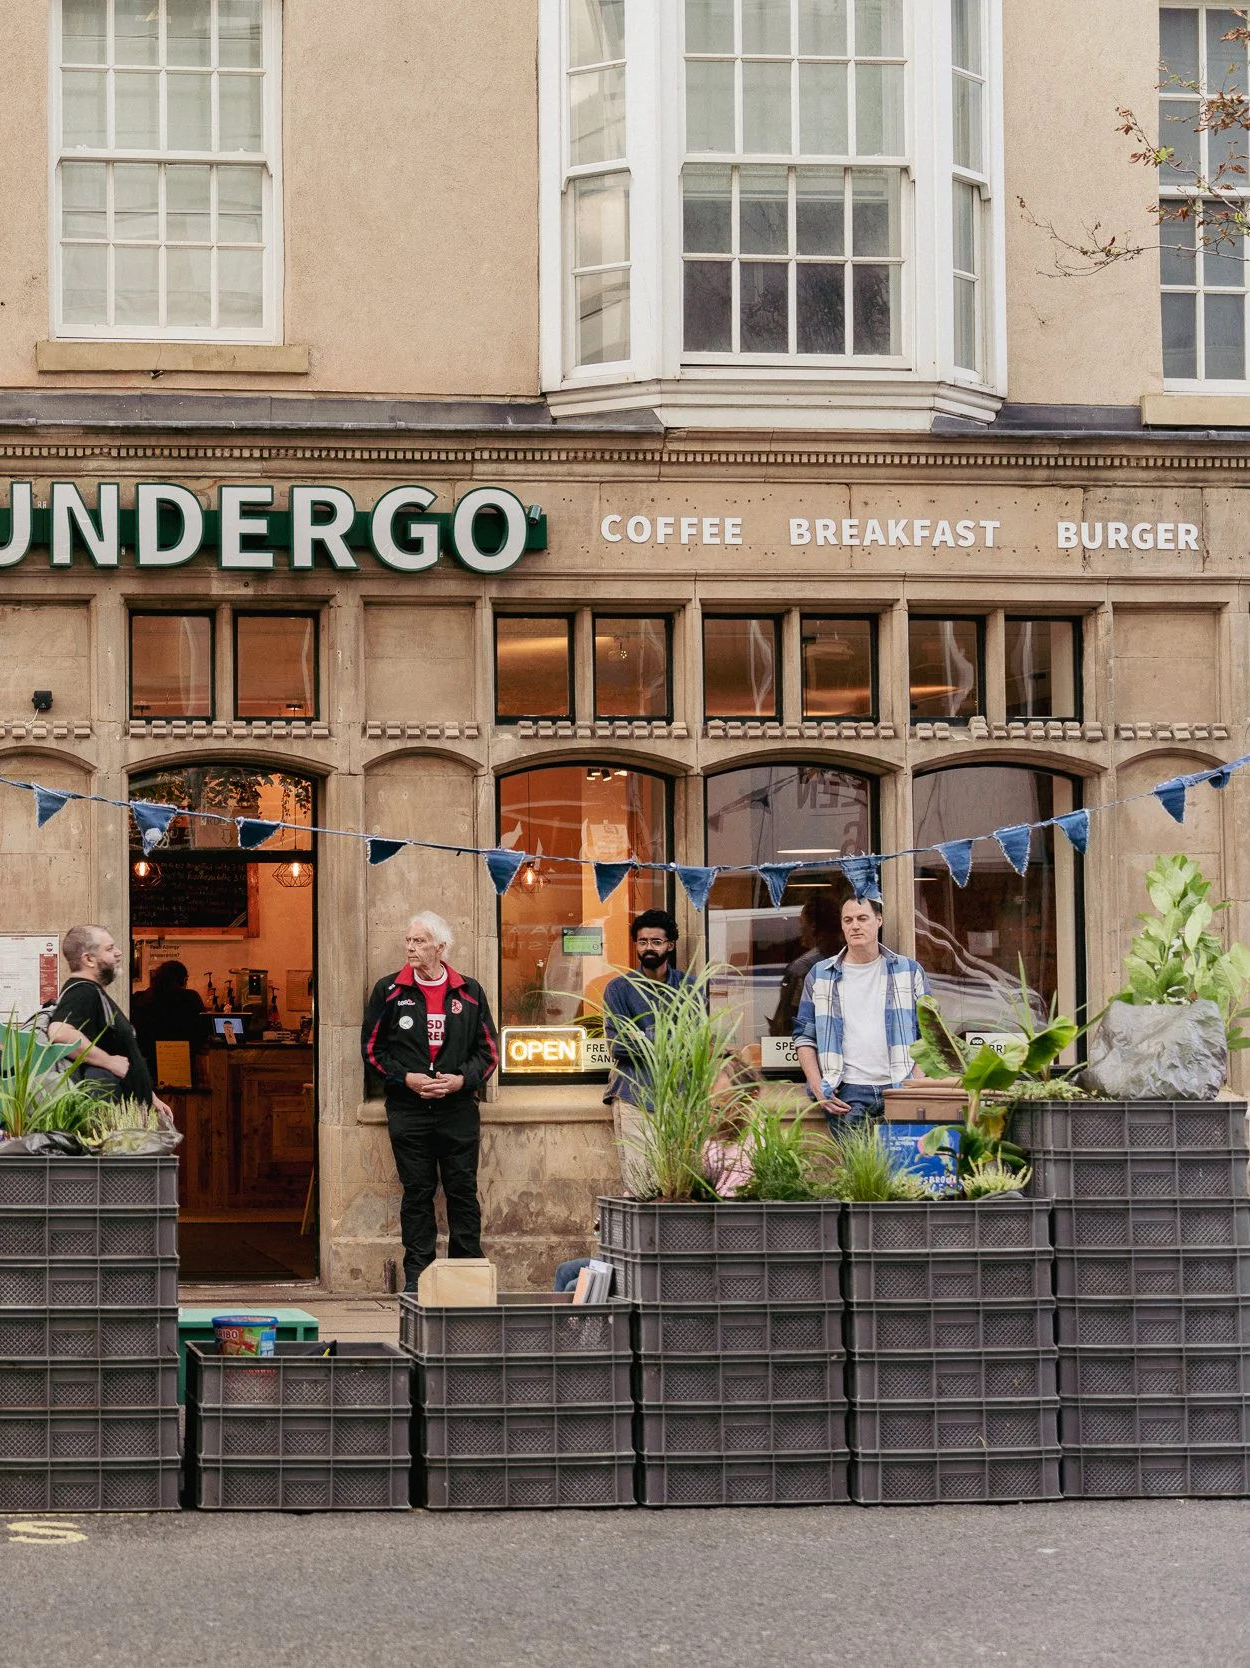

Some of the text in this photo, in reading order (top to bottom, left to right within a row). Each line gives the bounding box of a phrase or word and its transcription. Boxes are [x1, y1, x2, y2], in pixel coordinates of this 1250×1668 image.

[601, 514, 1200, 550] COFFEE BREAKFAST BURGER
[511, 1041, 576, 1061] OPEN
